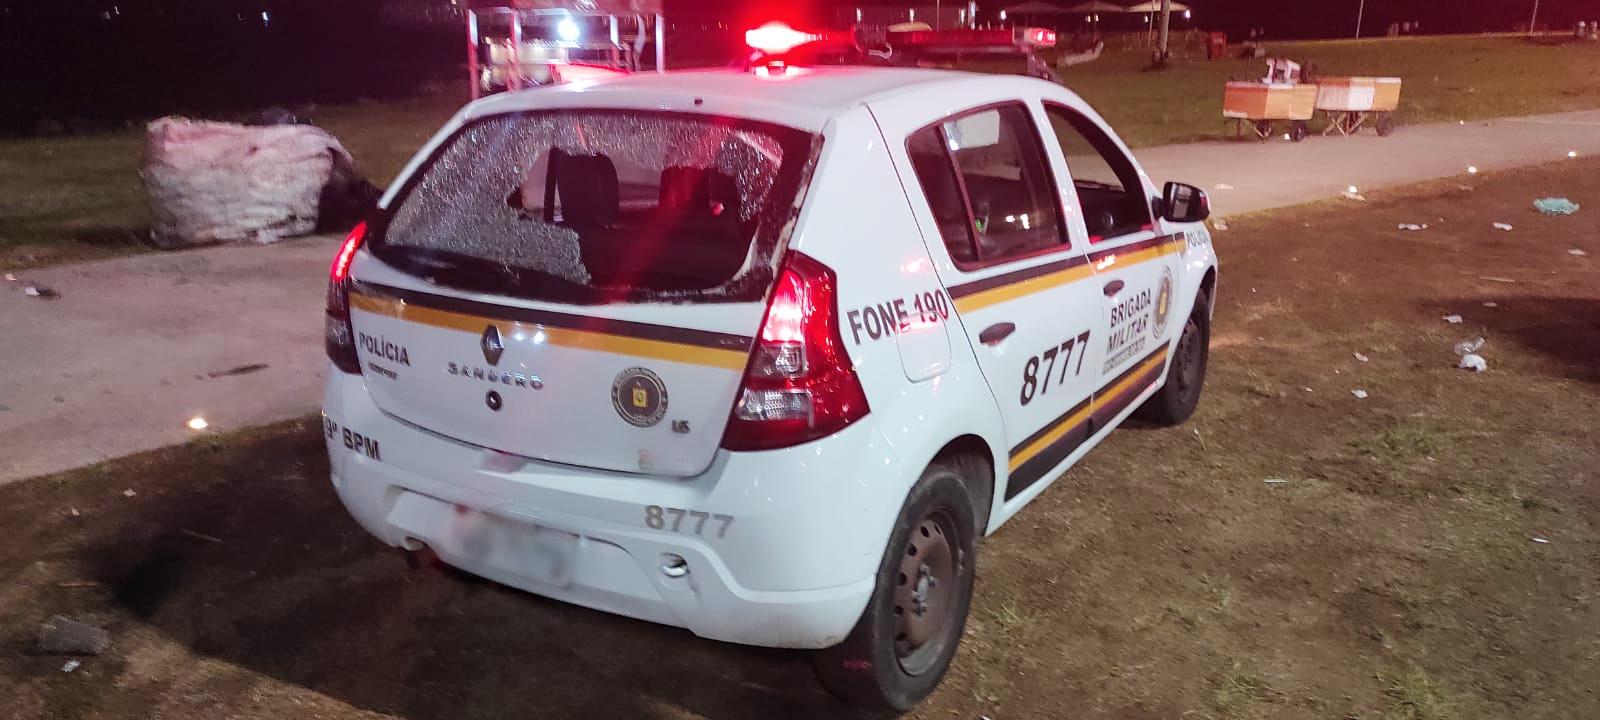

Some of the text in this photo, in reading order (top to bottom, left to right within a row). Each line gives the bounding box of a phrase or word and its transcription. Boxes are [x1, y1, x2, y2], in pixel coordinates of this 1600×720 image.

[847, 289, 949, 345] FONE 190
[1110, 288, 1151, 328] BRIGADA
[359, 331, 411, 367] POLÍCIA
[1106, 313, 1149, 355] MILITAR
[447, 361, 544, 390] SANDERO
[1020, 329, 1091, 406] 8777
[342, 426, 382, 462] BPM
[645, 505, 734, 539] 8777
